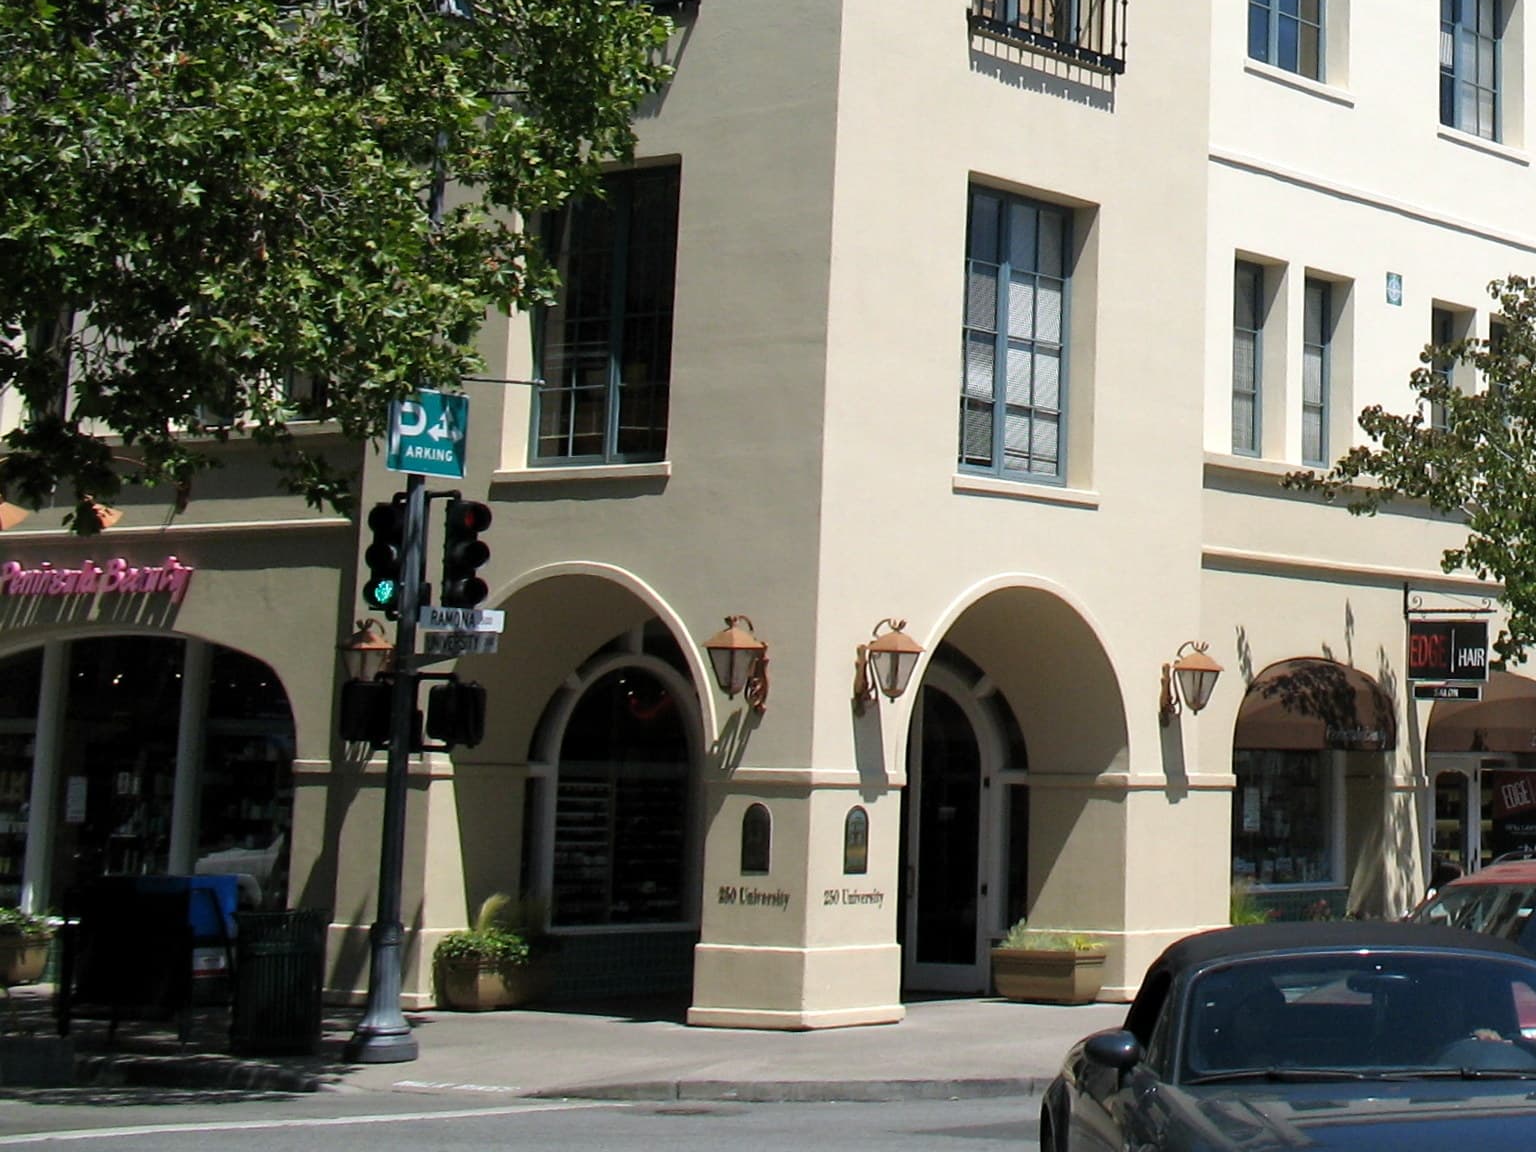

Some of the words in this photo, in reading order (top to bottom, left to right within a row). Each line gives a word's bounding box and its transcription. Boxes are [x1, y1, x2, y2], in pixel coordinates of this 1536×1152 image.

[431, 609, 476, 629] RAMONA
[1410, 634, 1447, 667] EDGE
[1458, 647, 1485, 667] HAIR
[739, 888, 791, 912] University
[823, 889, 840, 906] 250
[842, 888, 884, 909] University
